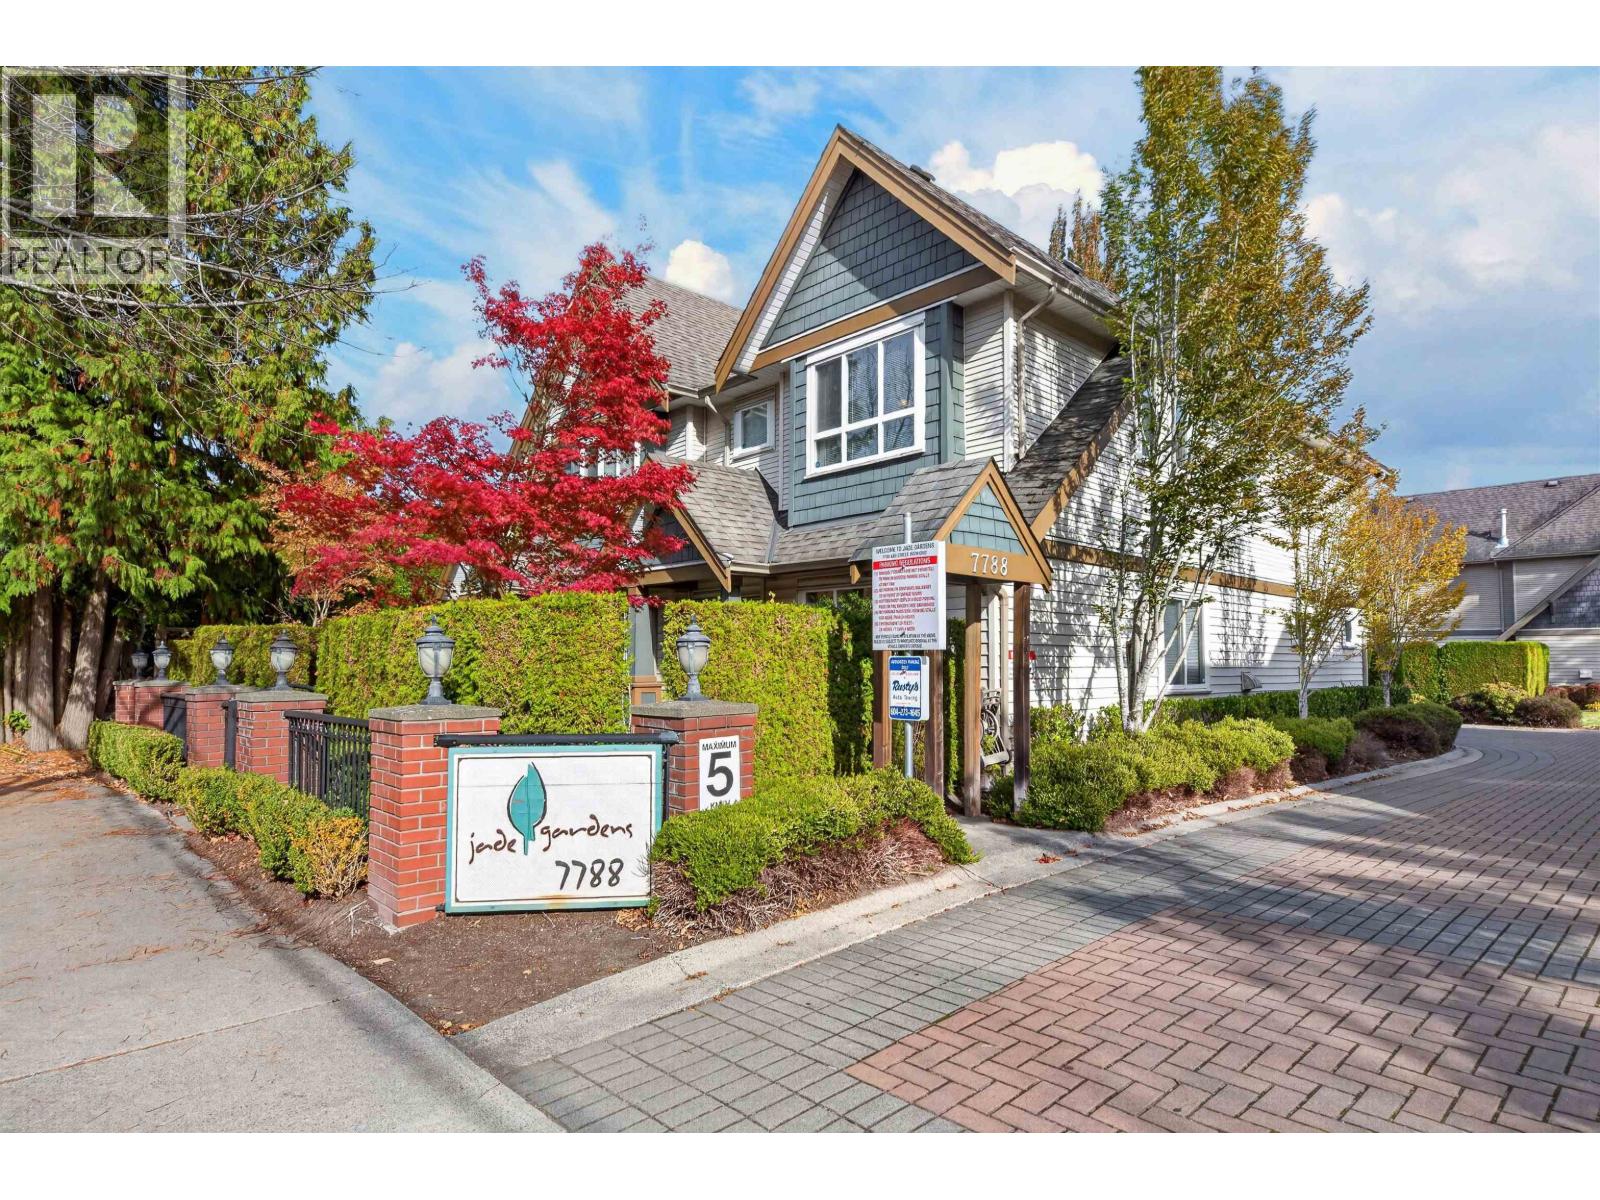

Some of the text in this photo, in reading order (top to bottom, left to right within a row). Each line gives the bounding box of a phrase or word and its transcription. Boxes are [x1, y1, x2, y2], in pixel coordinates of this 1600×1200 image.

[879, 558, 931, 568] PARKING REGULATIONS
[970, 552, 1008, 576] 7788
[892, 680, 919, 694] Rusty's
[702, 740, 737, 751] MAXIMUM
[706, 751, 733, 797] 5
[468, 814, 633, 864] jade gardens
[555, 858, 624, 890] 7788
